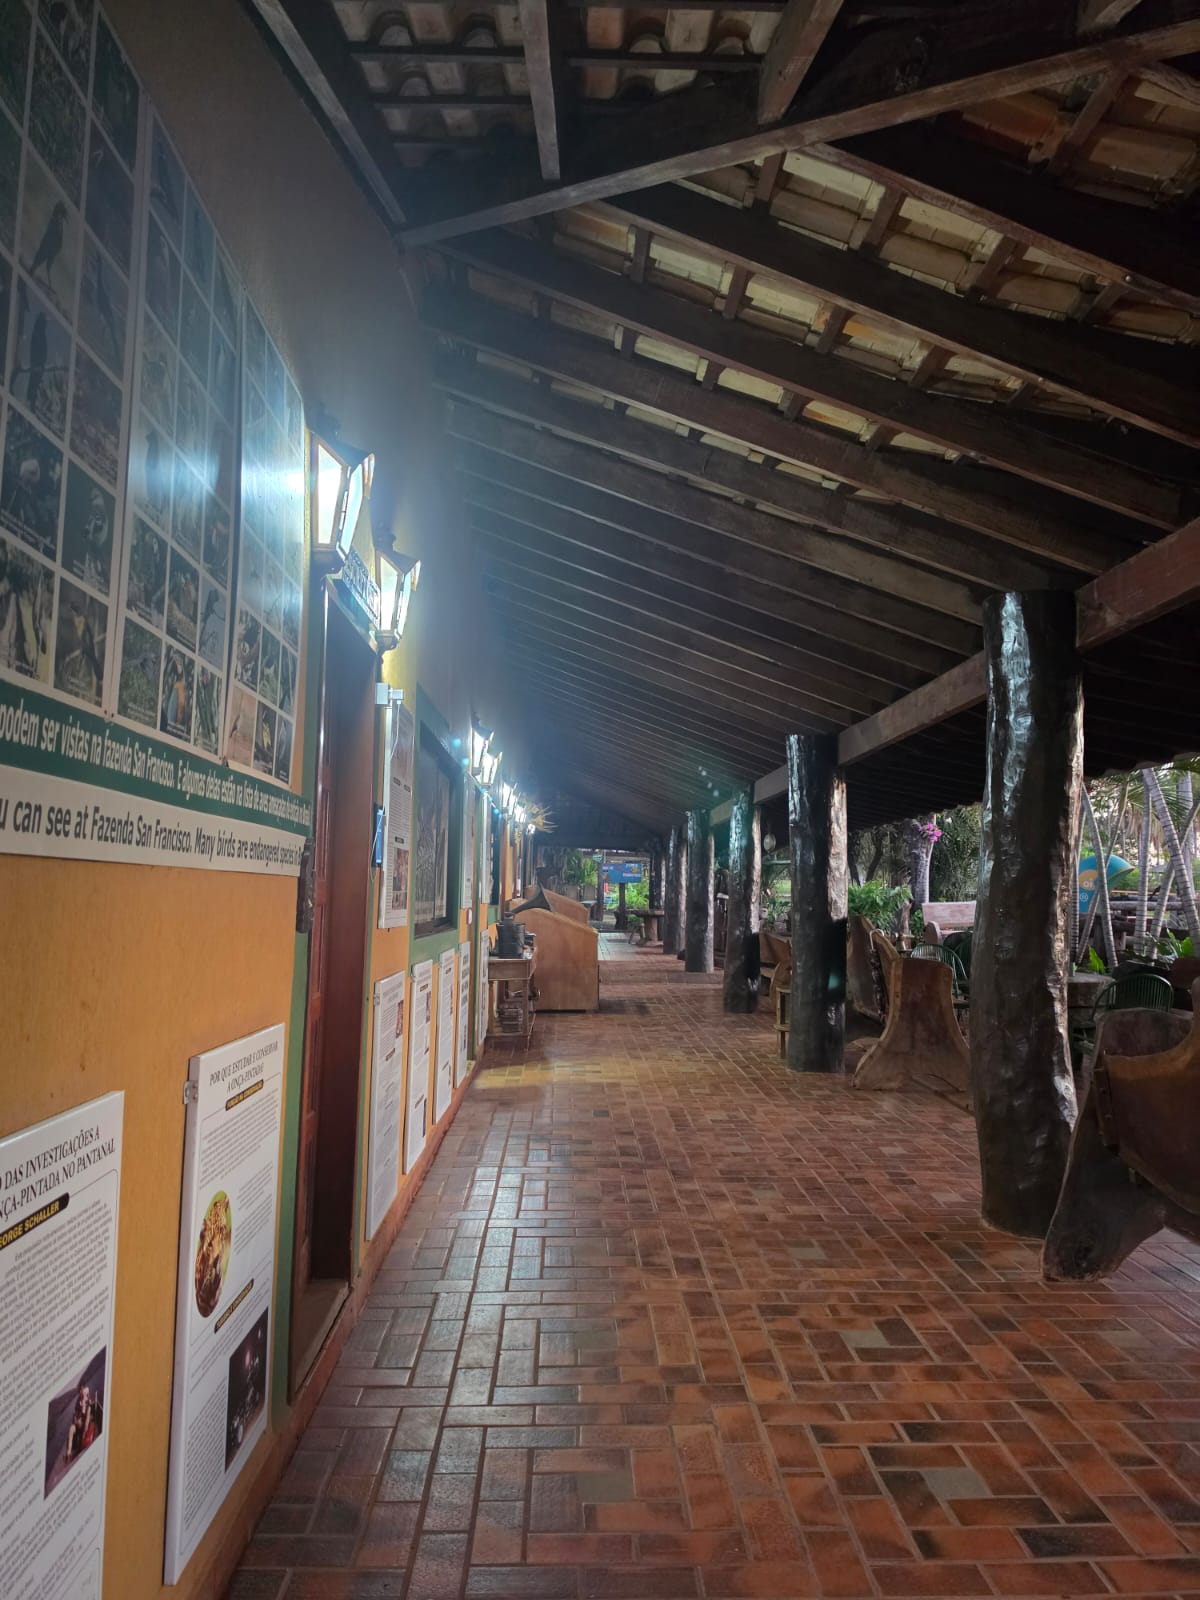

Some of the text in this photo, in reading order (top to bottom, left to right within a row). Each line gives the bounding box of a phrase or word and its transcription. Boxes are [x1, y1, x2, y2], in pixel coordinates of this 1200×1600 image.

[41, 718, 60, 752] ser
[61, 714, 90, 762] vistas
[90, 734, 102, 766] na
[102, 729, 132, 775] fazenda
[133, 741, 146, 778] San
[177, 759, 183, 790] E
[206, 769, 221, 801] delas
[221, 774, 236, 805] estão
[13, 800, 42, 834] can
[46, 806, 71, 838] see
[74, 805, 88, 839] at
[91, 806, 134, 846] Fazenda
[136, 815, 152, 848] San
[153, 819, 192, 853] Francisco.
[195, 827, 215, 863] Many
[217, 829, 236, 858] birds
[237, 840, 248, 859] are
[5, 1164, 24, 1191] DAS
[25, 1128, 94, 1179] INVESTIGAÇÕES
[94, 1124, 100, 1141] A
[62, 1160, 76, 1183] NO
[77, 1138, 116, 1174] PANTANAL
[24, 1201, 60, 1231] SCHALLER
